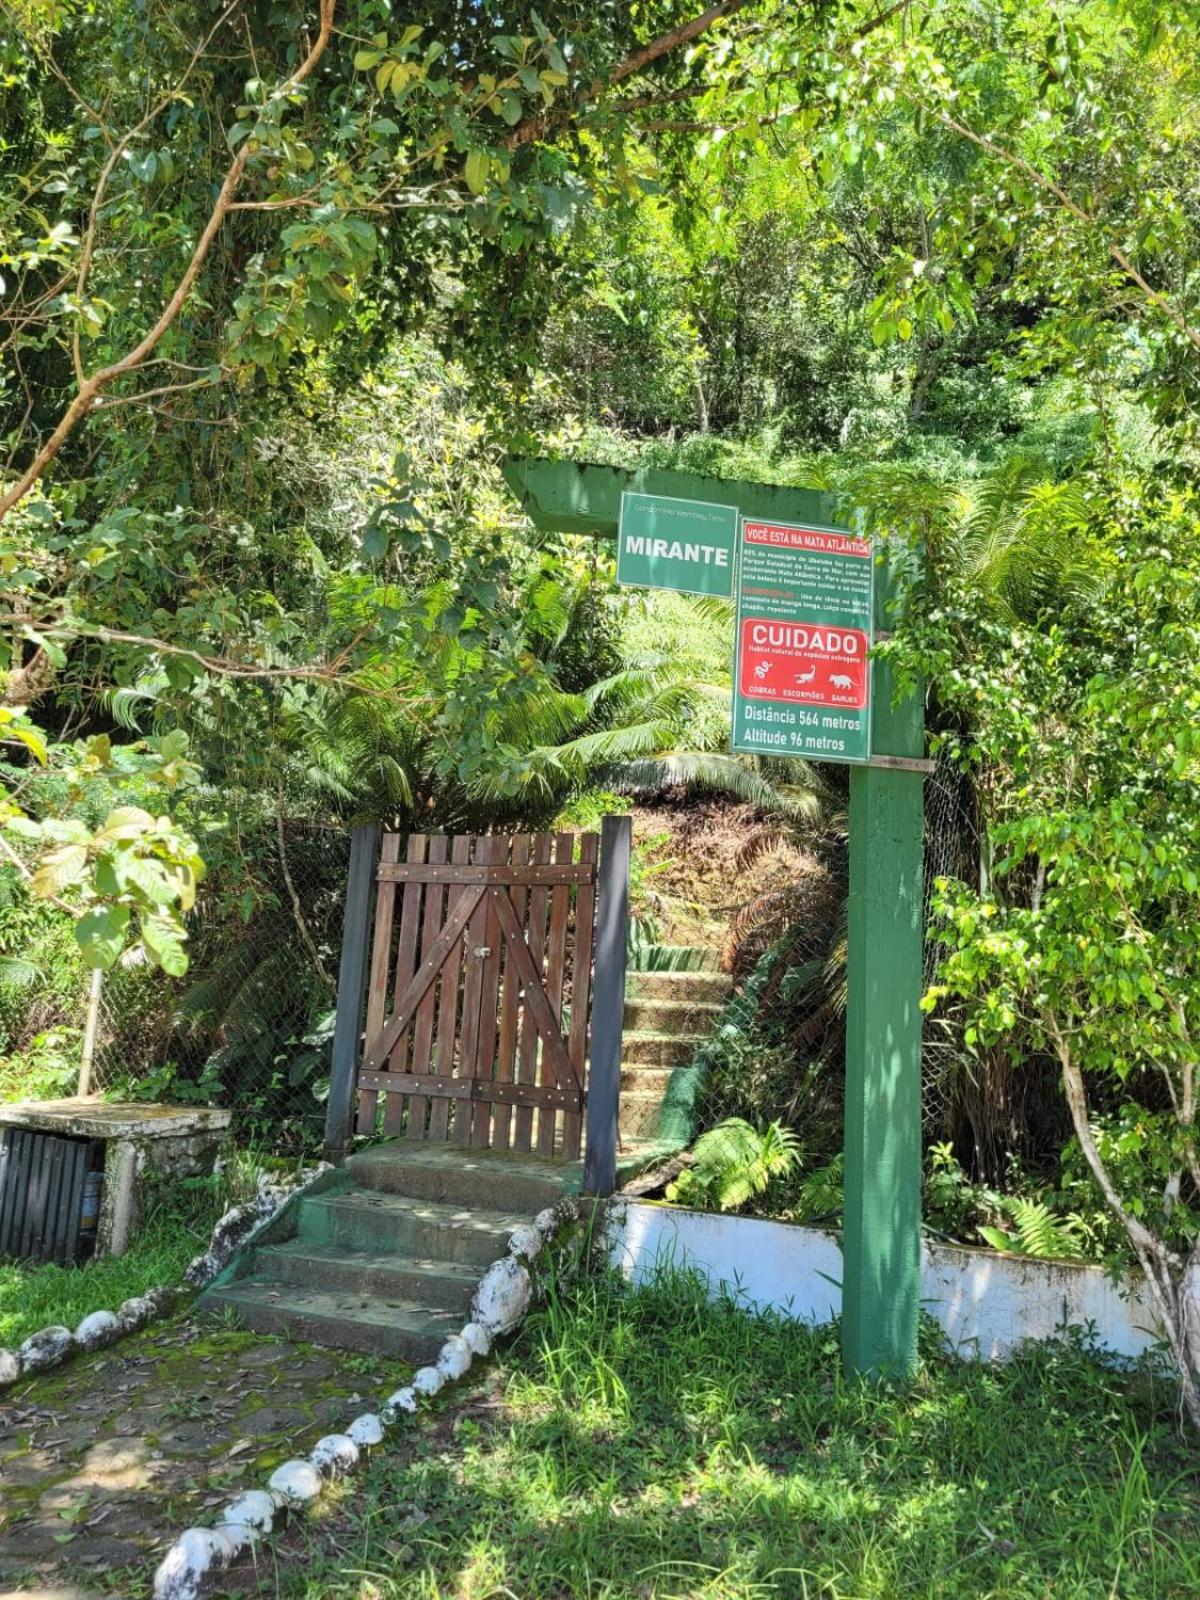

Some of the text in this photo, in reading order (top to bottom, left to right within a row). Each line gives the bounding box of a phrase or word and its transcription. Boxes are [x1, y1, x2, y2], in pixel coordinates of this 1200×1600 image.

[625, 536, 728, 567] MIRANTE
[748, 528, 868, 553] VOCÊ ESTÁ NA MATA ATLÂNTICA
[752, 625, 857, 654] CUIDADO
[749, 686, 776, 695] COBRAS
[783, 689, 824, 700] ESCORPIÕES
[744, 705, 861, 730] Distância 564 metros
[744, 728, 844, 751] Altitude 96 metros
